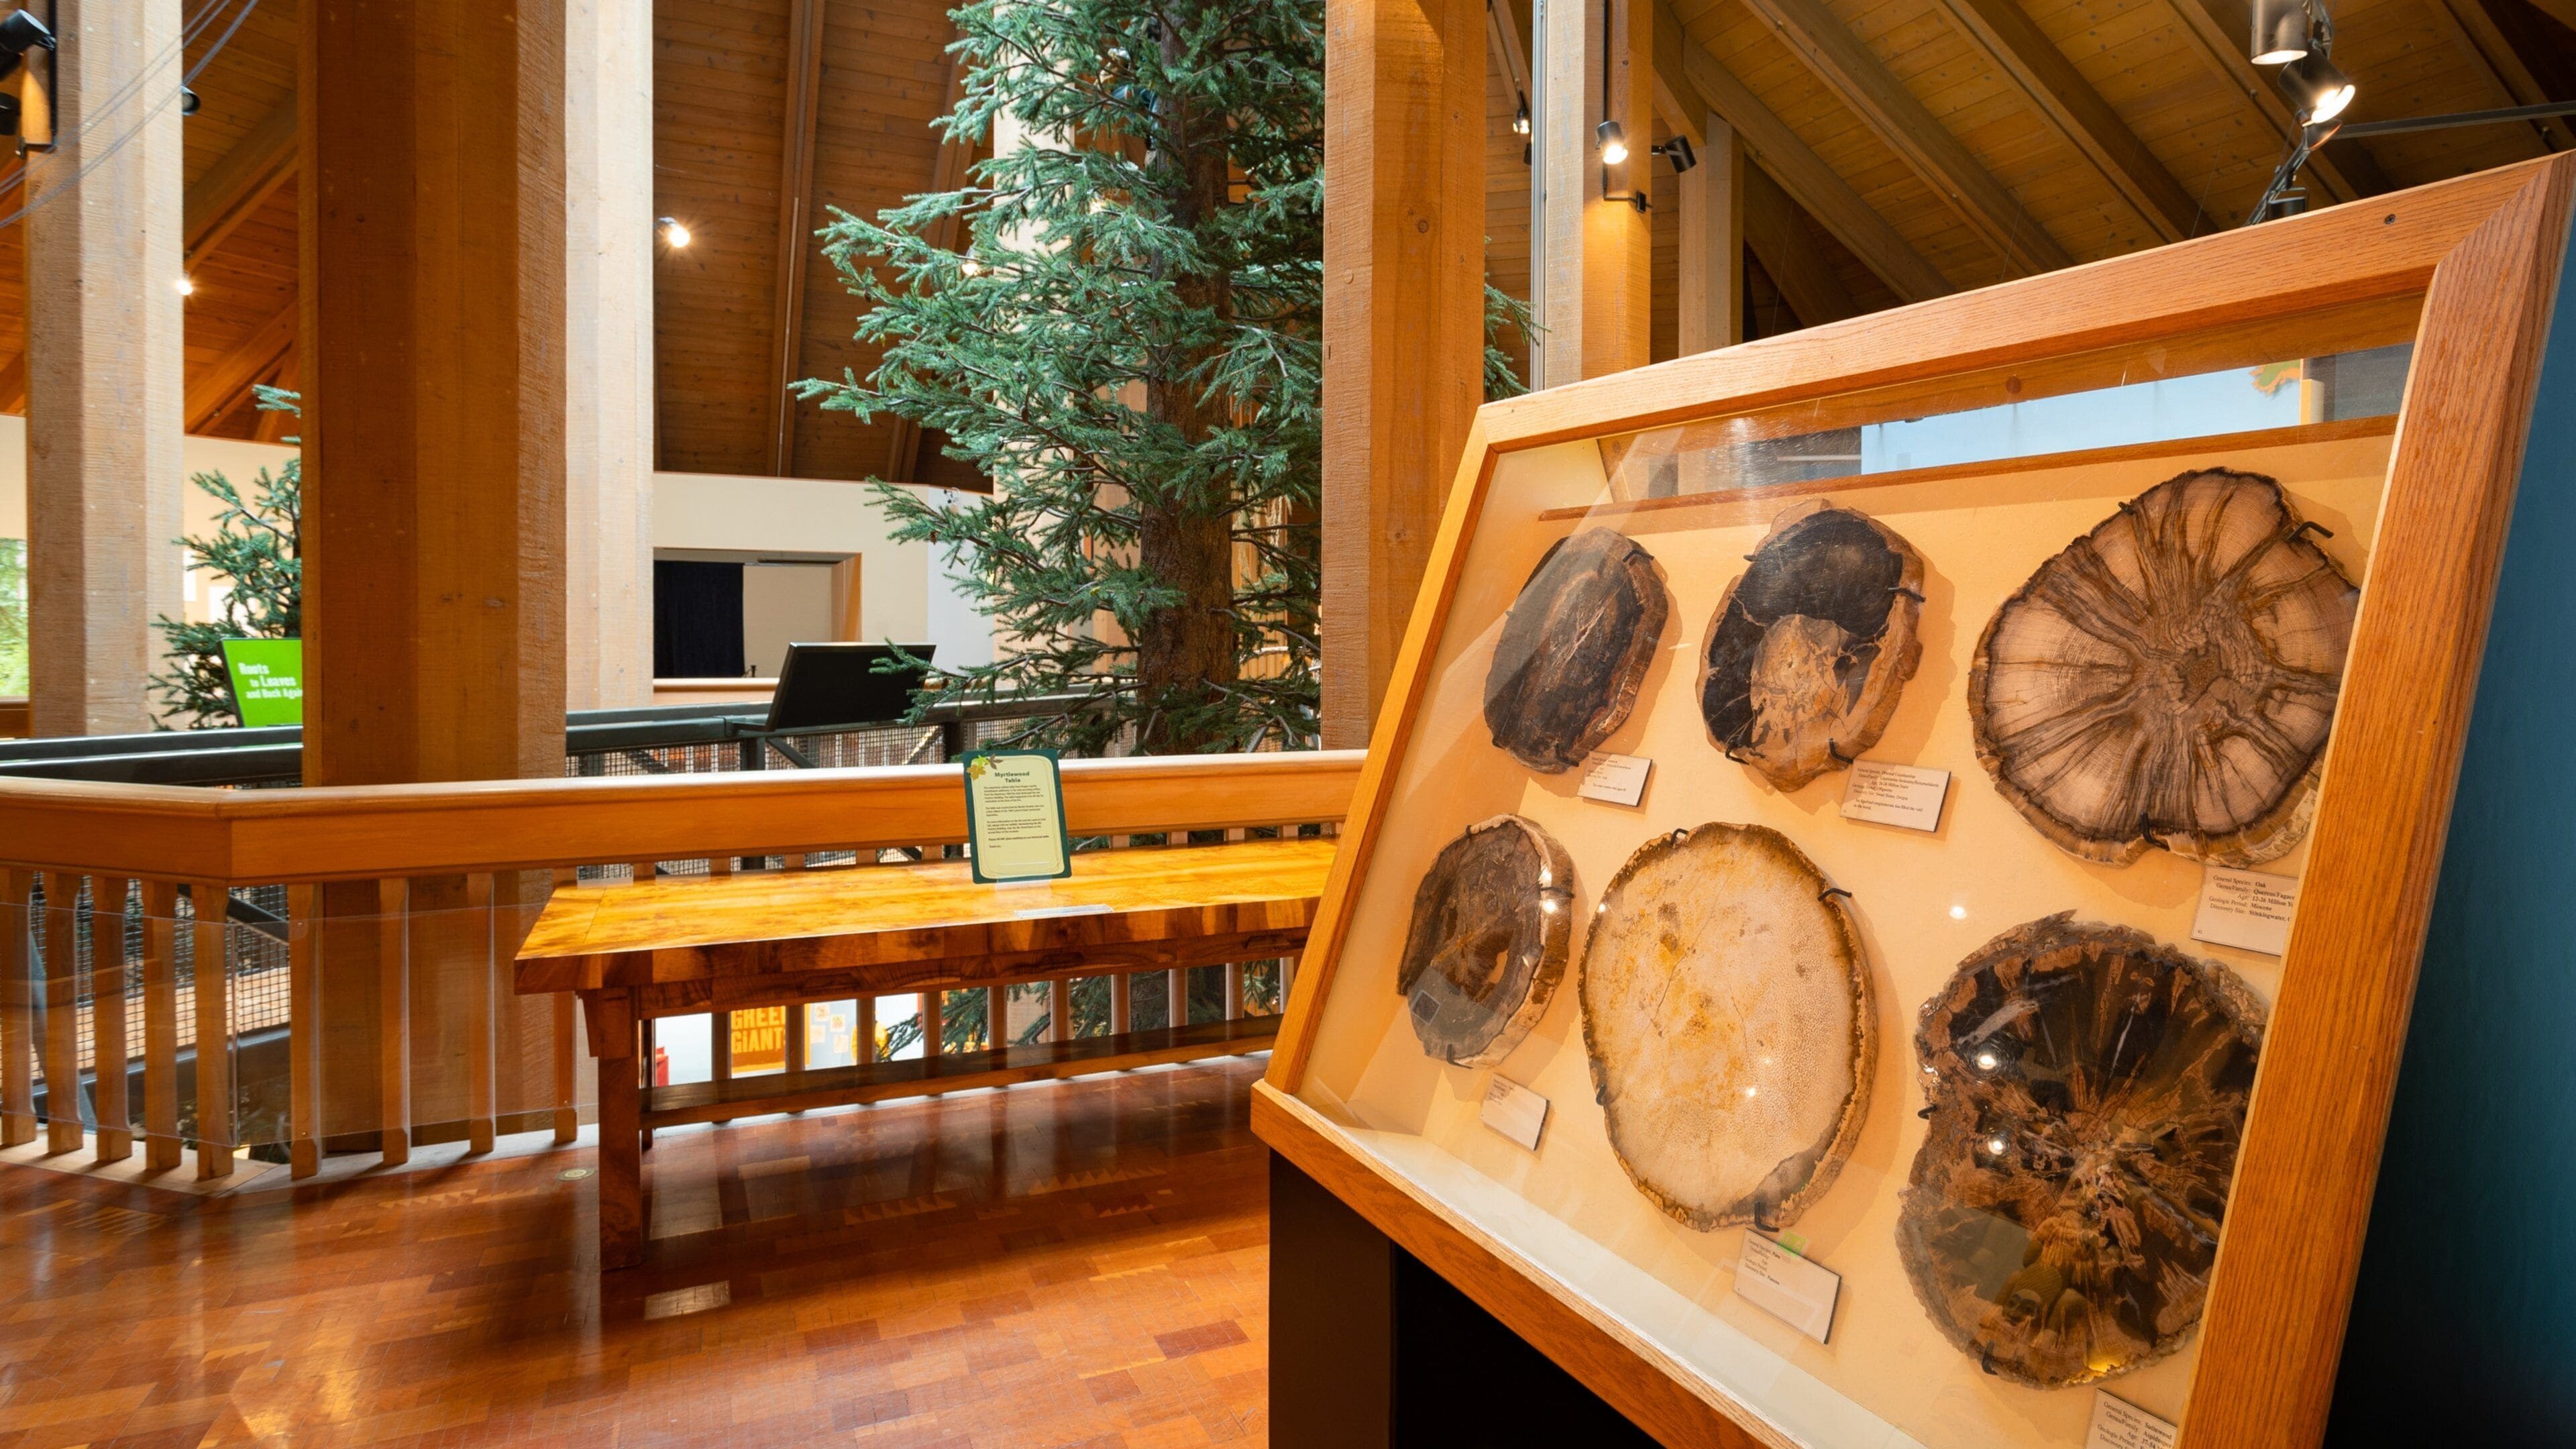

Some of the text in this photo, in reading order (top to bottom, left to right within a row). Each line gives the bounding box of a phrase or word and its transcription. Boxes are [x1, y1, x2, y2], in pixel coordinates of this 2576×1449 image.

[237, 662, 270, 675] Roots
[250, 675, 297, 687] to Leaves
[246, 689, 261, 698] and
[261, 688, 281, 698] Back
